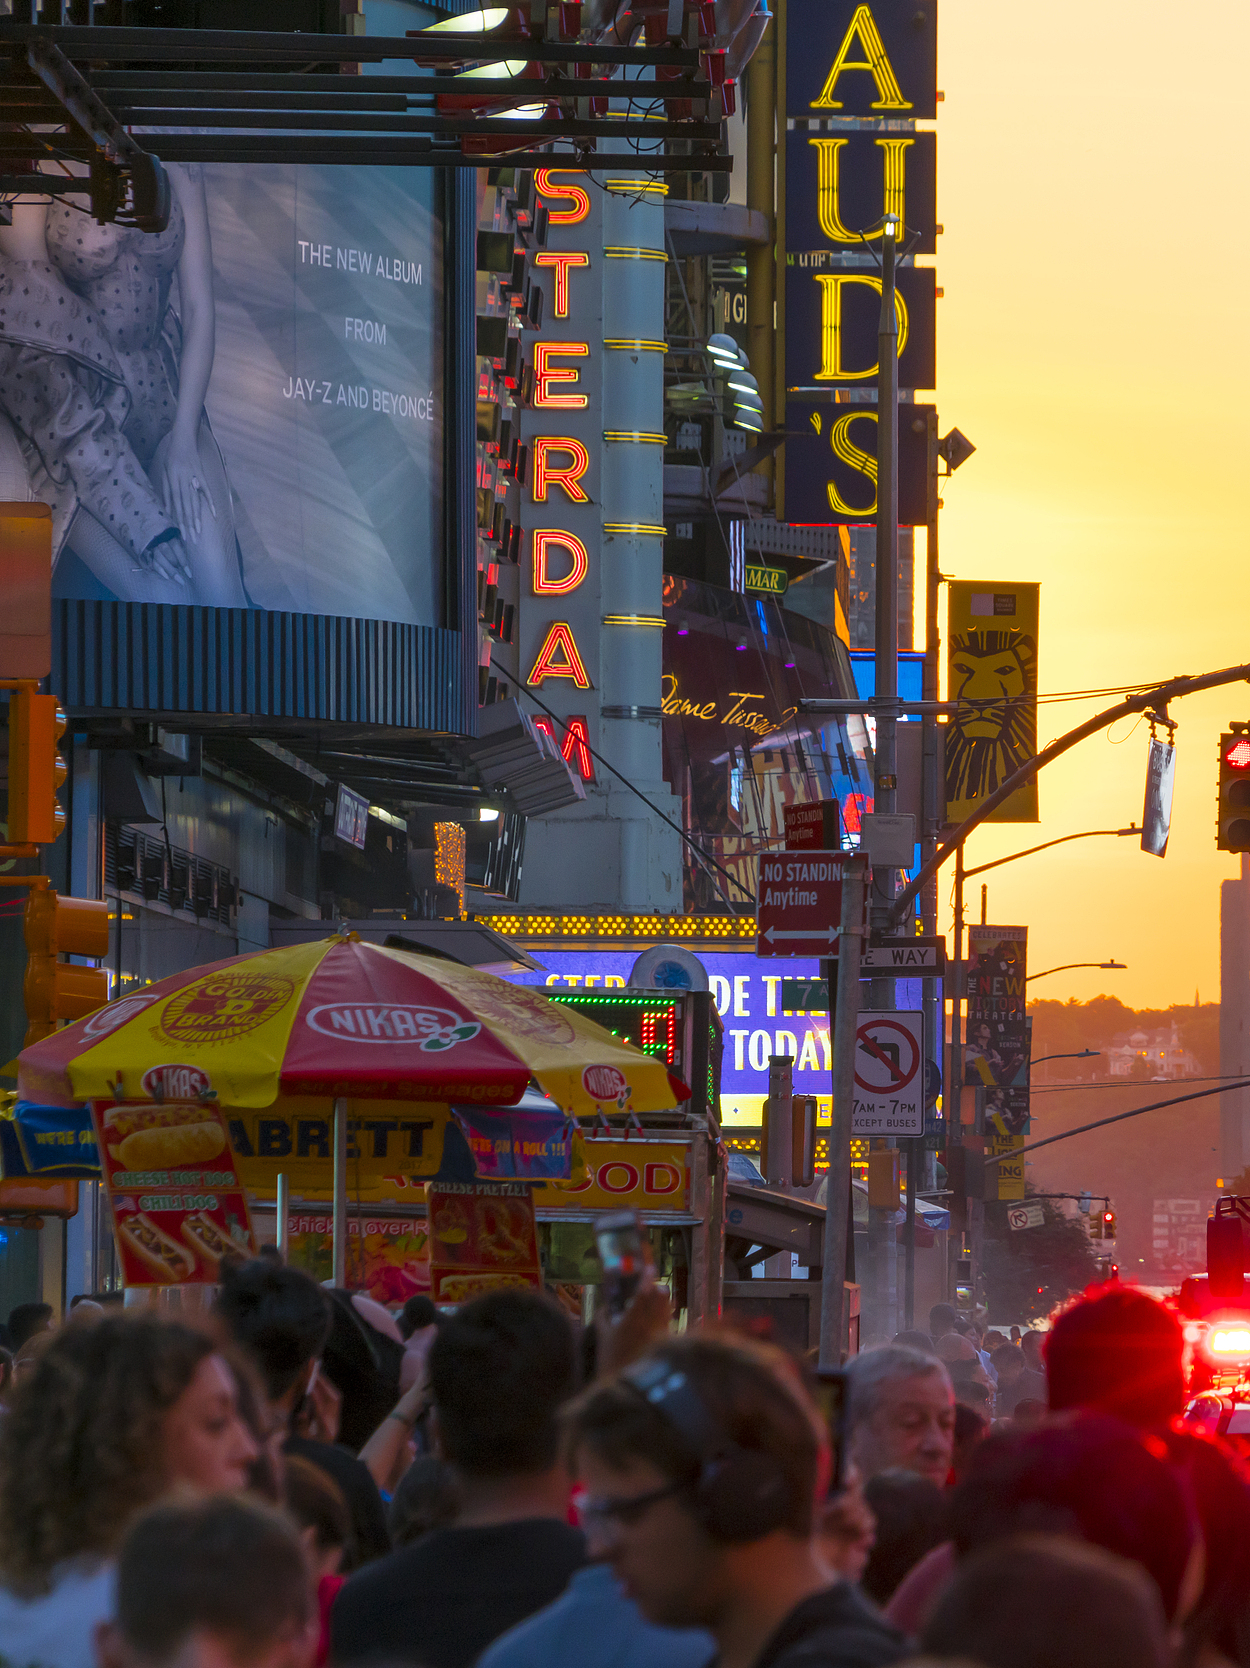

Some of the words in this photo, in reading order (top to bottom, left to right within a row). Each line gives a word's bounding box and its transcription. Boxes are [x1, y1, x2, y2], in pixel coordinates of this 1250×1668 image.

[298, 240, 332, 268] THE
[337, 247, 372, 274] NEW
[375, 255, 422, 286] ALBUM
[345, 317, 387, 345] FROM
[282, 376, 332, 404] JAY-Z
[336, 384, 369, 409] AND
[372, 391, 434, 421] BEYONCÉ
[786, 815, 796, 825] NO
[796, 808, 823, 825] STANDIN
[788, 827, 814, 843] Anytime
[764, 863, 782, 882] NO
[786, 863, 844, 882] STANDIN
[764, 887, 818, 911] Anytime
[973, 930, 1021, 940] CELEBRATES
[891, 949, 929, 965] WAY
[205, 983, 286, 1000] GOLDEN
[968, 977, 977, 995] THE
[979, 976, 1026, 996] NEW
[796, 984, 813, 1007] 7
[330, 1009, 441, 1037] NIKAS
[968, 1010, 1023, 1021] THEATER
[889, 1100, 916, 1114] 7PM
[852, 1118, 883, 1128] XCEPT
[886, 1118, 917, 1128] BUSES
[112, 1171, 169, 1187] CHEESE
[171, 1171, 201, 1187] HOT
[203, 1171, 235, 1187] DOG
[998, 1165, 1022, 1177] ING
[138, 1195, 183, 1212] CHILI
[184, 1195, 219, 1211] DOG
[287, 1216, 360, 1236] Chickn
[364, 1220, 408, 1236] over
